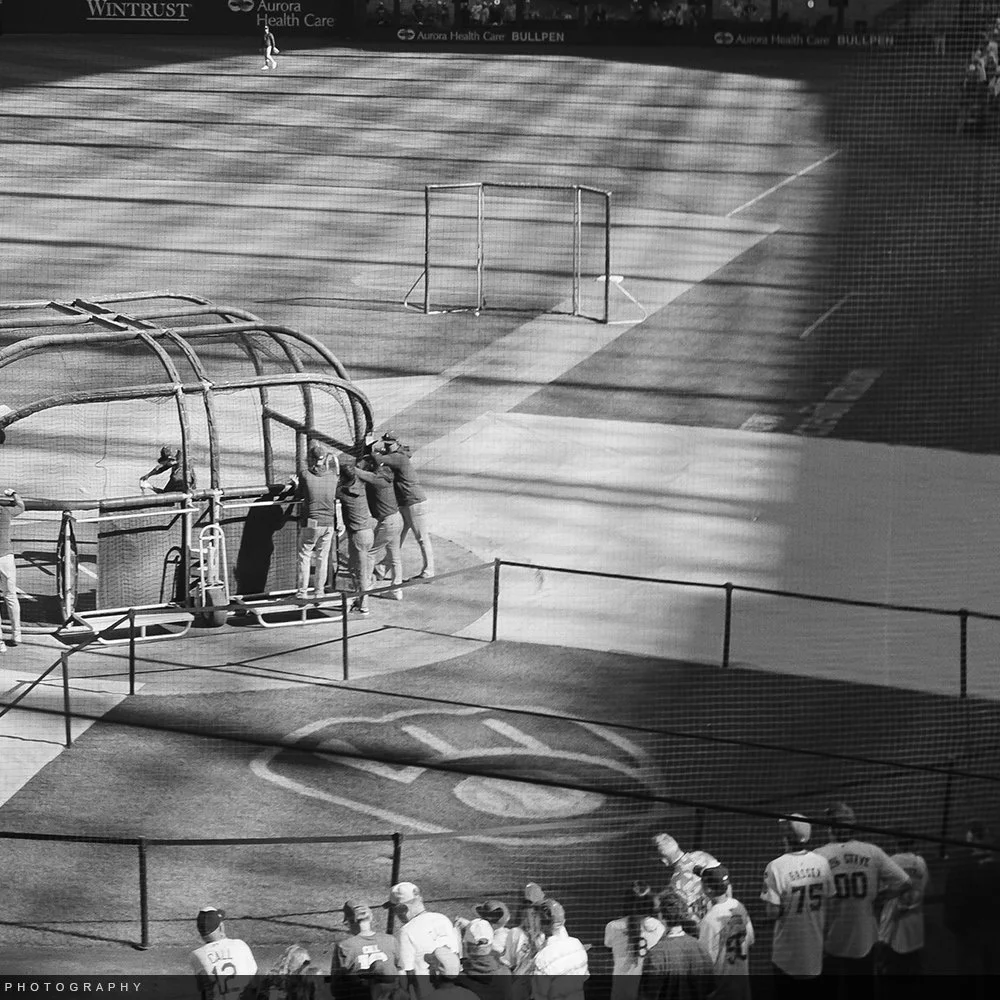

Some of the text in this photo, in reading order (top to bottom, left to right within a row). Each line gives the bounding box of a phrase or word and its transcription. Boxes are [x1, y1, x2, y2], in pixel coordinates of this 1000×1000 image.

[86, 0, 190, 17] WINTRUST
[257, 0, 302, 12] Aurora
[257, 13, 335, 27] Health Care
[417, 31, 564, 41] Aurora Health Care BULLPEN
[736, 34, 894, 46] Aurora Health Care BULLPEN
[834, 871, 867, 899] 00
[791, 882, 823, 913] 75
